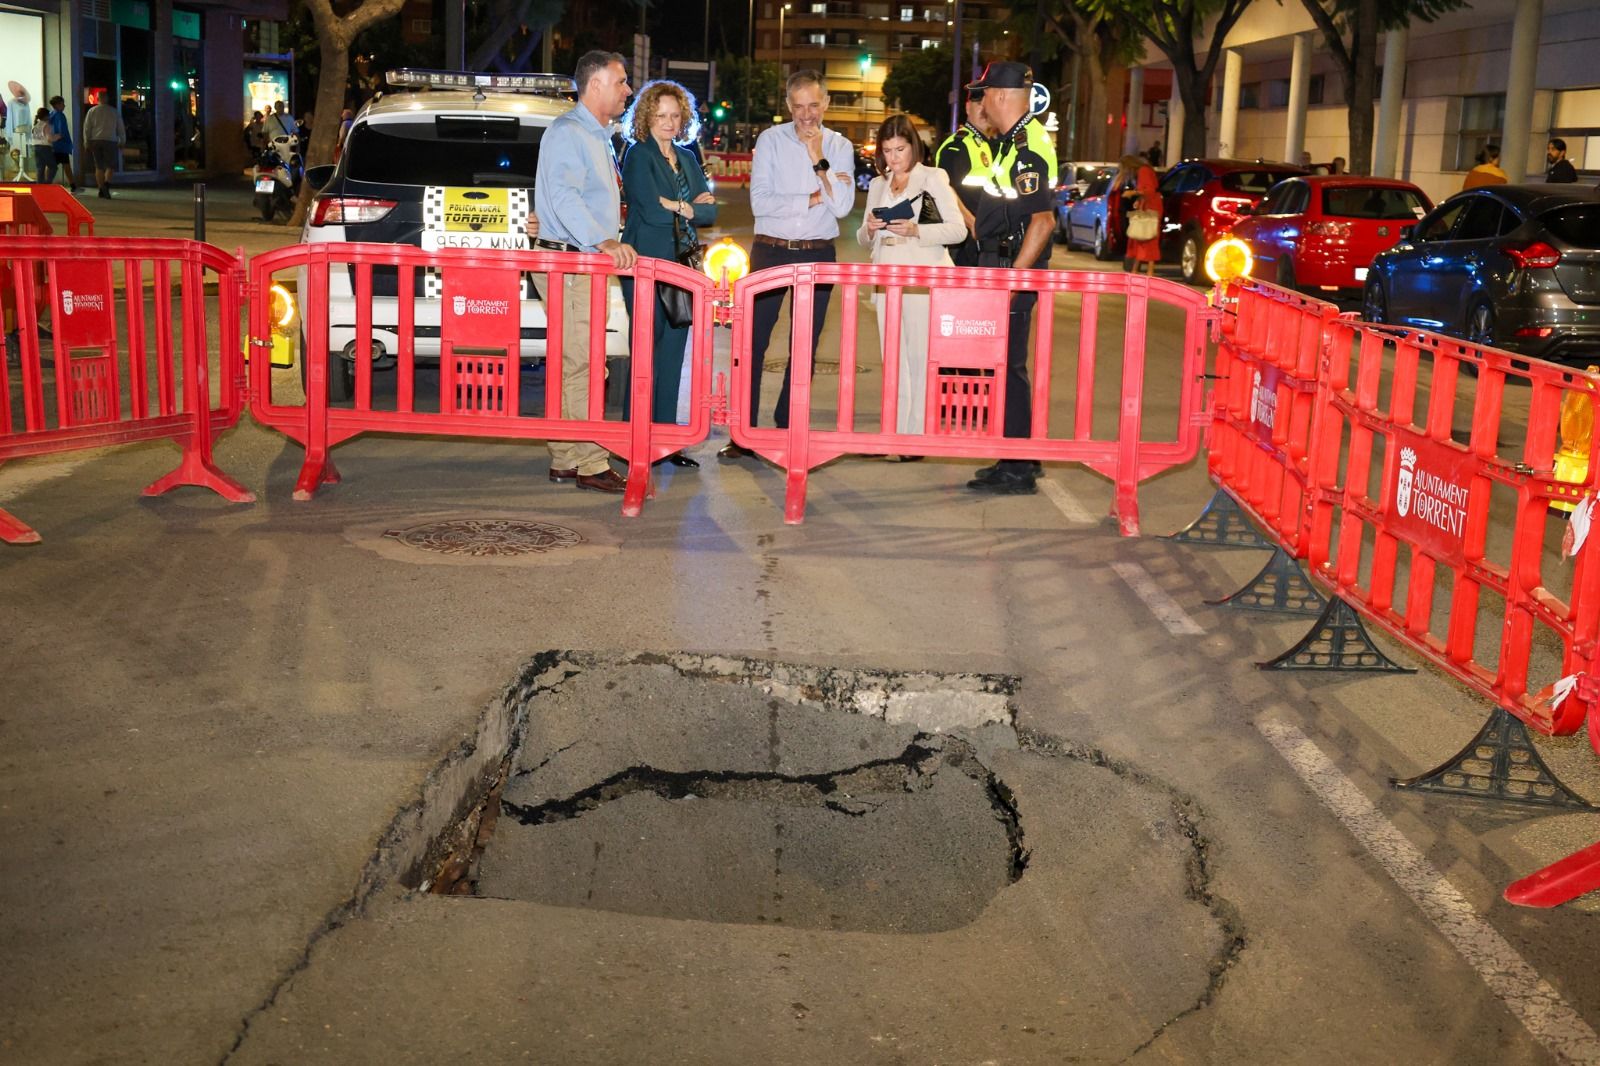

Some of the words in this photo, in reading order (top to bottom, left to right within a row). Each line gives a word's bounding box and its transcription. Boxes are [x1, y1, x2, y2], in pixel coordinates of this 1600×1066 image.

[449, 203, 477, 212] POLICIA
[479, 204, 502, 213] LOCAL
[445, 213, 507, 224] TORRENT
[436, 235, 483, 249] 9562
[490, 236, 525, 250] MNM
[466, 299, 509, 308] AJUNTAMENT
[466, 305, 510, 316] TORRENT
[955, 319, 997, 328] AJUNTAMENT
[955, 325, 997, 337] TORRENT
[1414, 468, 1469, 509] AJUNTAMENT
[1412, 487, 1467, 538] TORRENT
